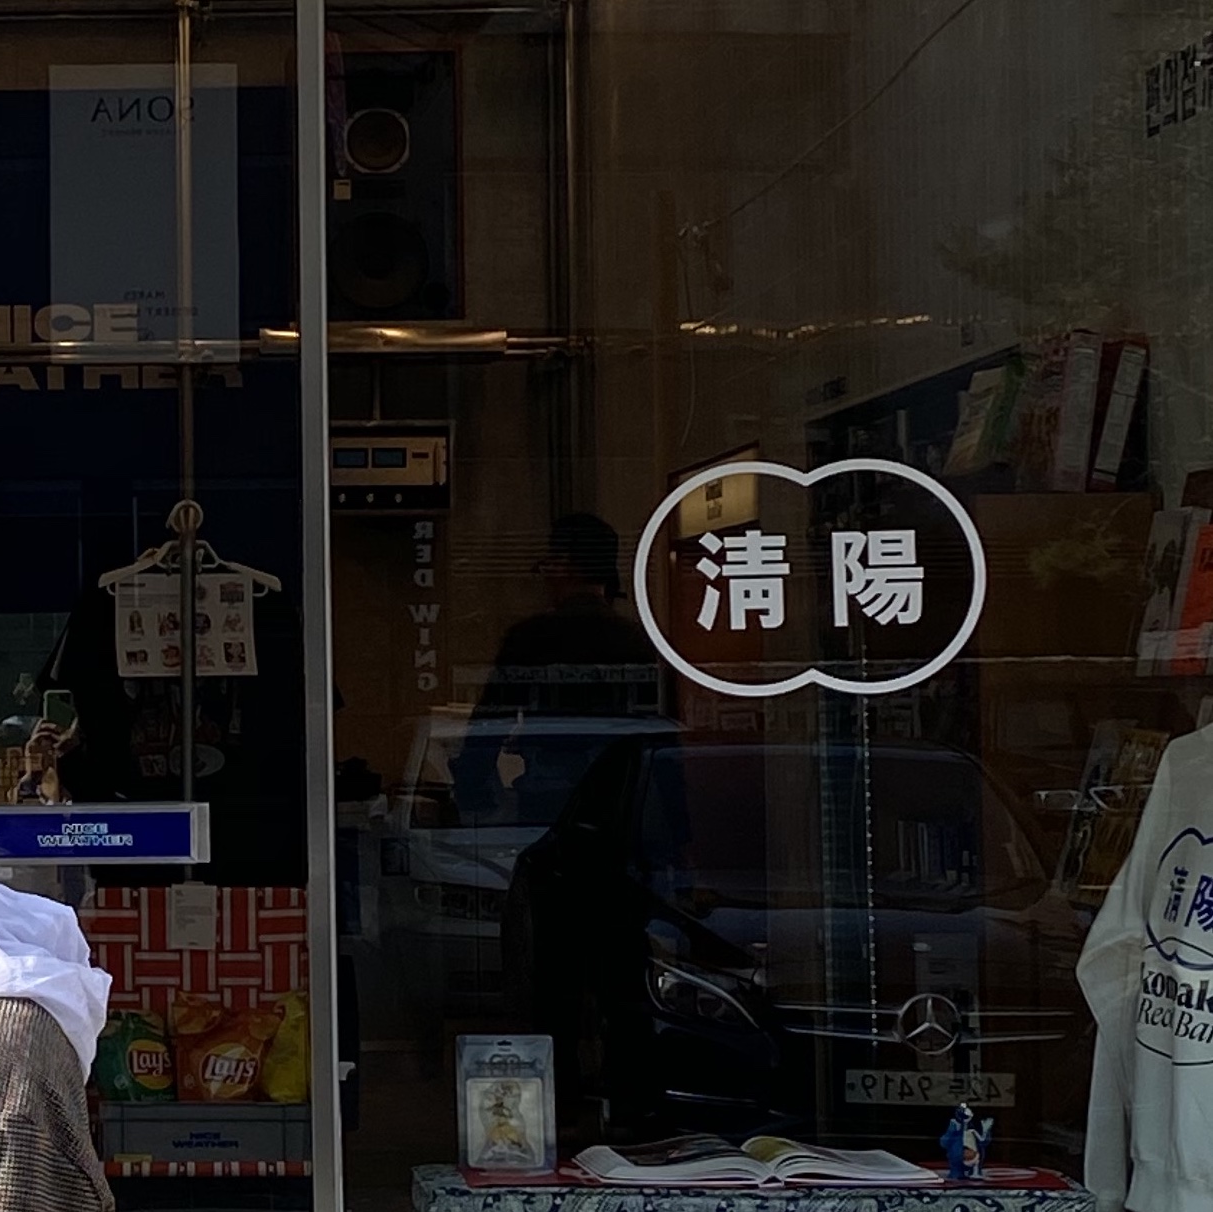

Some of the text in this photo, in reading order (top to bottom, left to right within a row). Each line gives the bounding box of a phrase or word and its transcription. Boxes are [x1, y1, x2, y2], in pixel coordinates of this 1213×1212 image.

[61, 823, 109, 834] NICE
[37, 834, 134, 847] WEATHER
[189, 1131, 221, 1140] NICE
[171, 1140, 239, 1148] WEATHER
